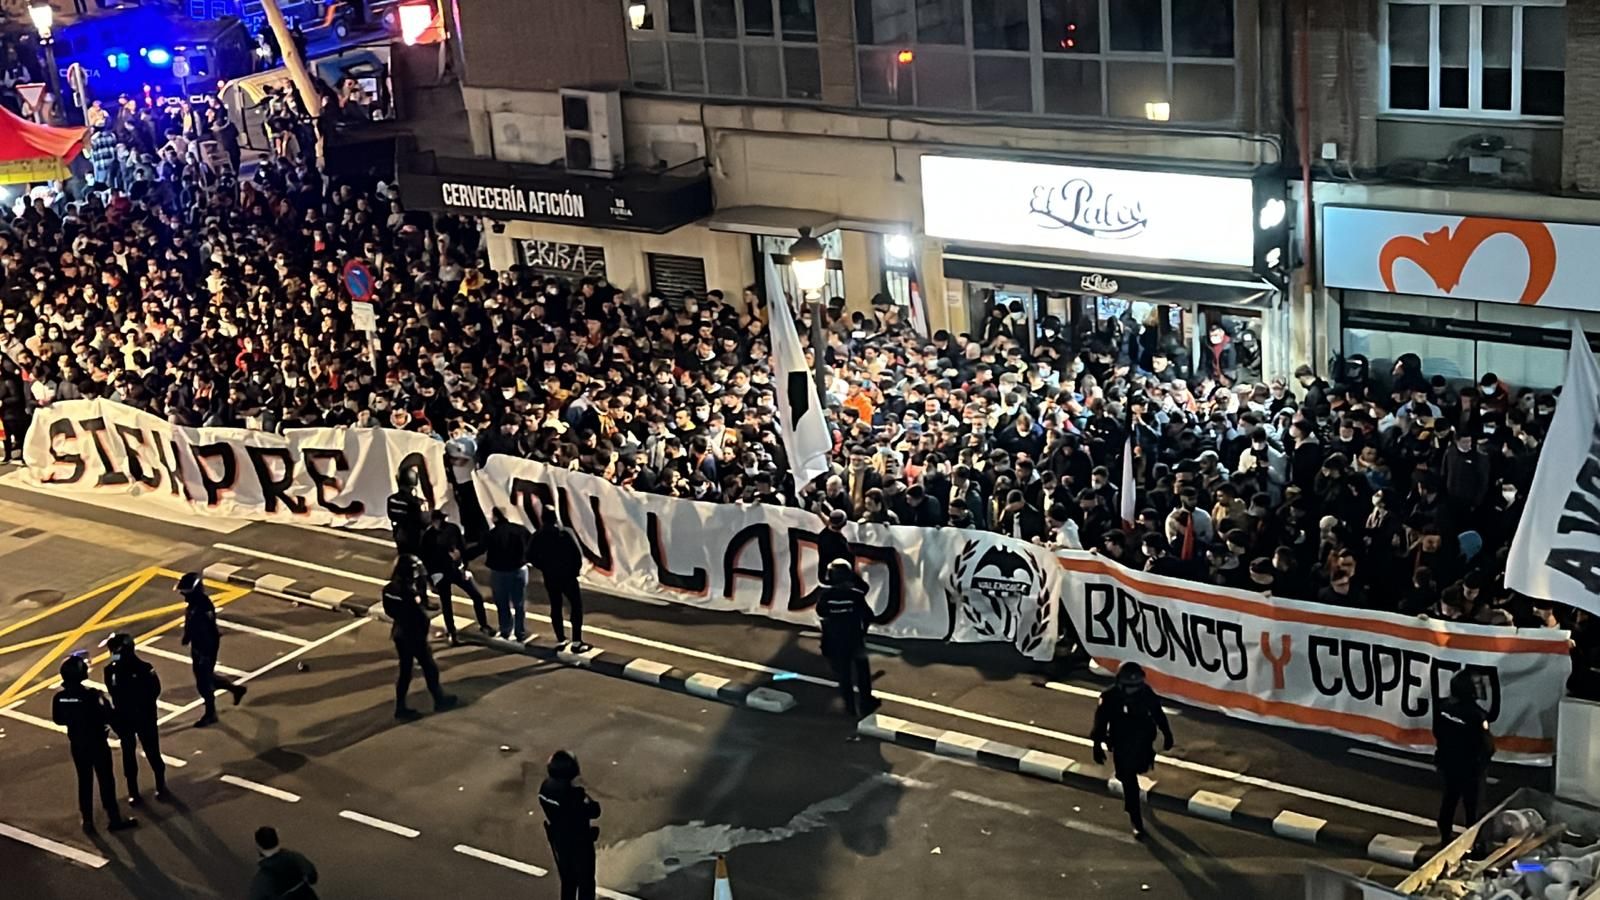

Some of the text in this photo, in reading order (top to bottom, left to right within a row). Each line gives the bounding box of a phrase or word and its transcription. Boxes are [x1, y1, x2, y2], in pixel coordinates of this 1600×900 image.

[442, 182, 584, 217] CERVECERÍA AFICIÓN
[647, 511, 905, 626] LADO
[1084, 582, 1249, 681] BRONCO
[1260, 630, 1292, 691] Y
